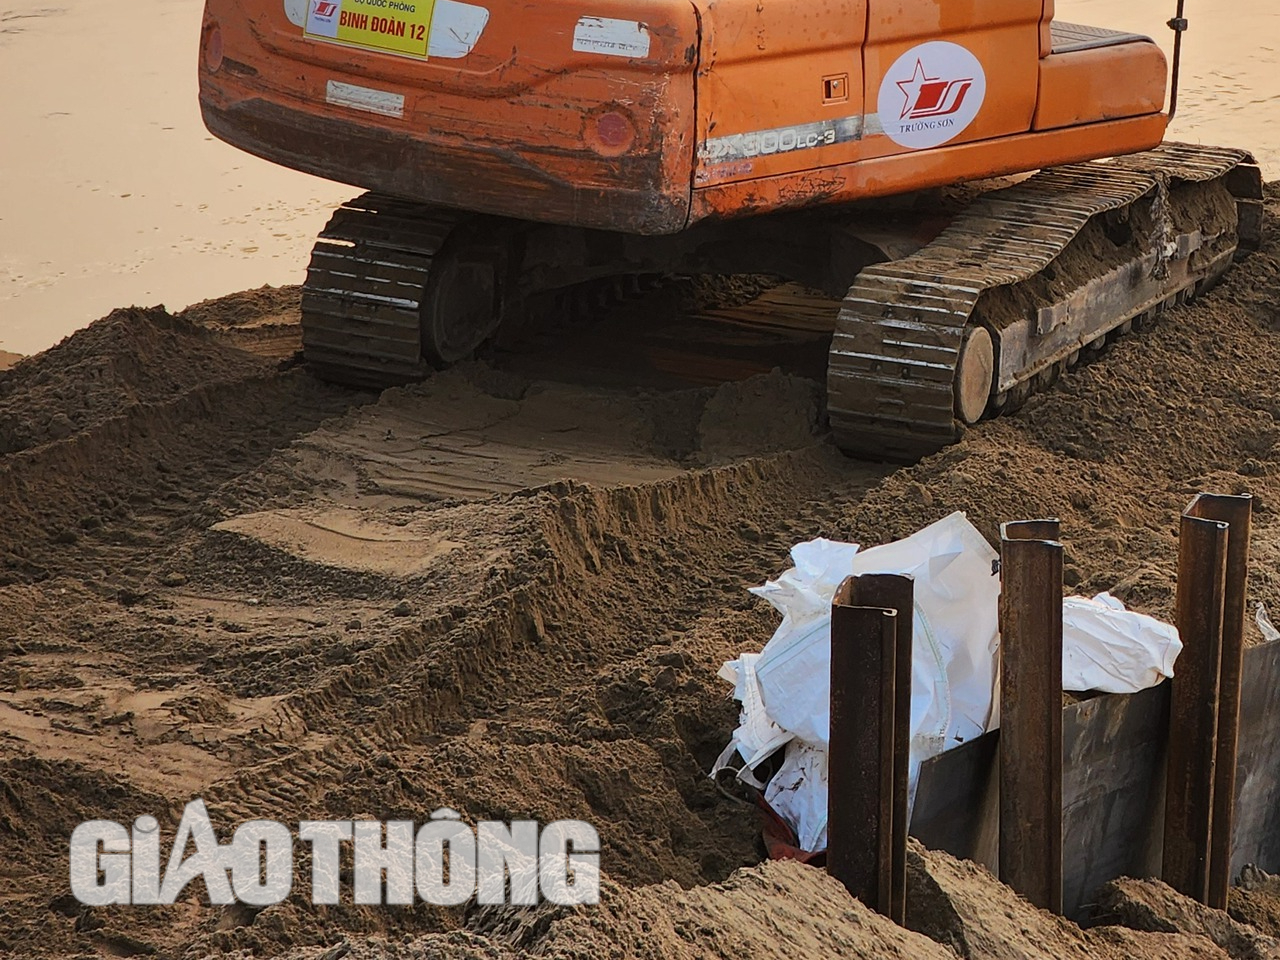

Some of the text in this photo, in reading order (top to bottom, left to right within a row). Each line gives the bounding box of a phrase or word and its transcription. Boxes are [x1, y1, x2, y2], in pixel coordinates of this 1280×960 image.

[388, 0, 416, 13] PHÒNG
[339, 10, 426, 41] BINH ĐOÀN 12
[900, 118, 955, 133] TRƯỜNG SƠN
